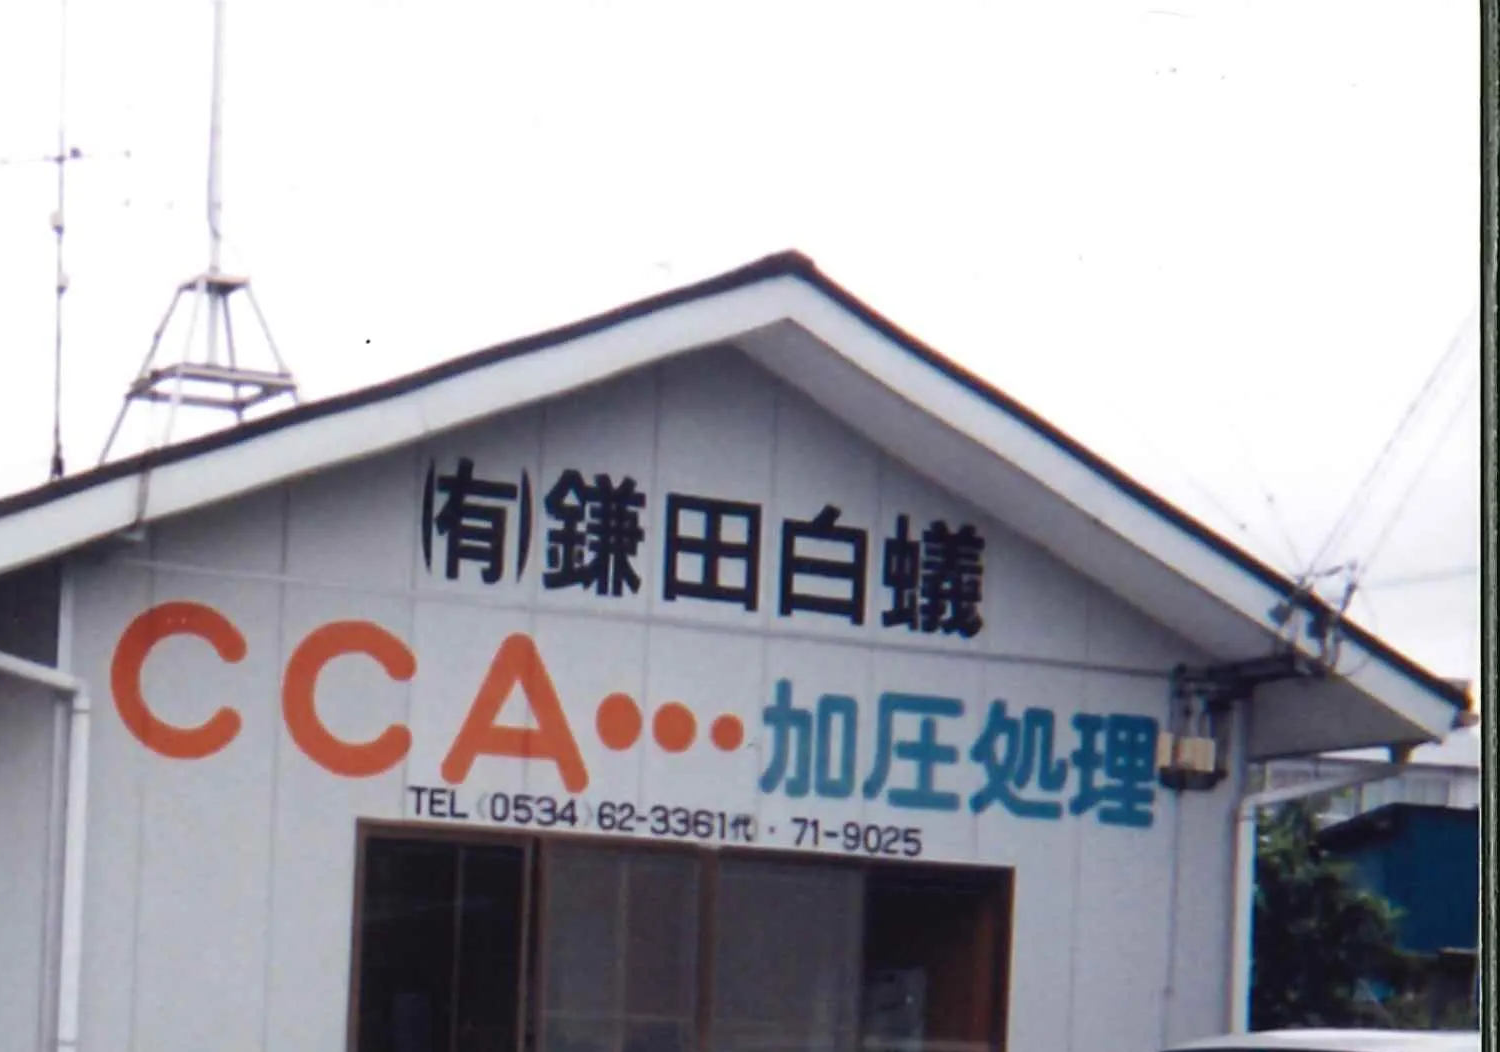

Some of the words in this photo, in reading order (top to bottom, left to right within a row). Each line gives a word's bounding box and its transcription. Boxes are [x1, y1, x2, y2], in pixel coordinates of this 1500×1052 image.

[758, 680, 1160, 828] 加圧処理
[407, 786, 470, 818] TEL
[791, 817, 923, 857] 71-9025
